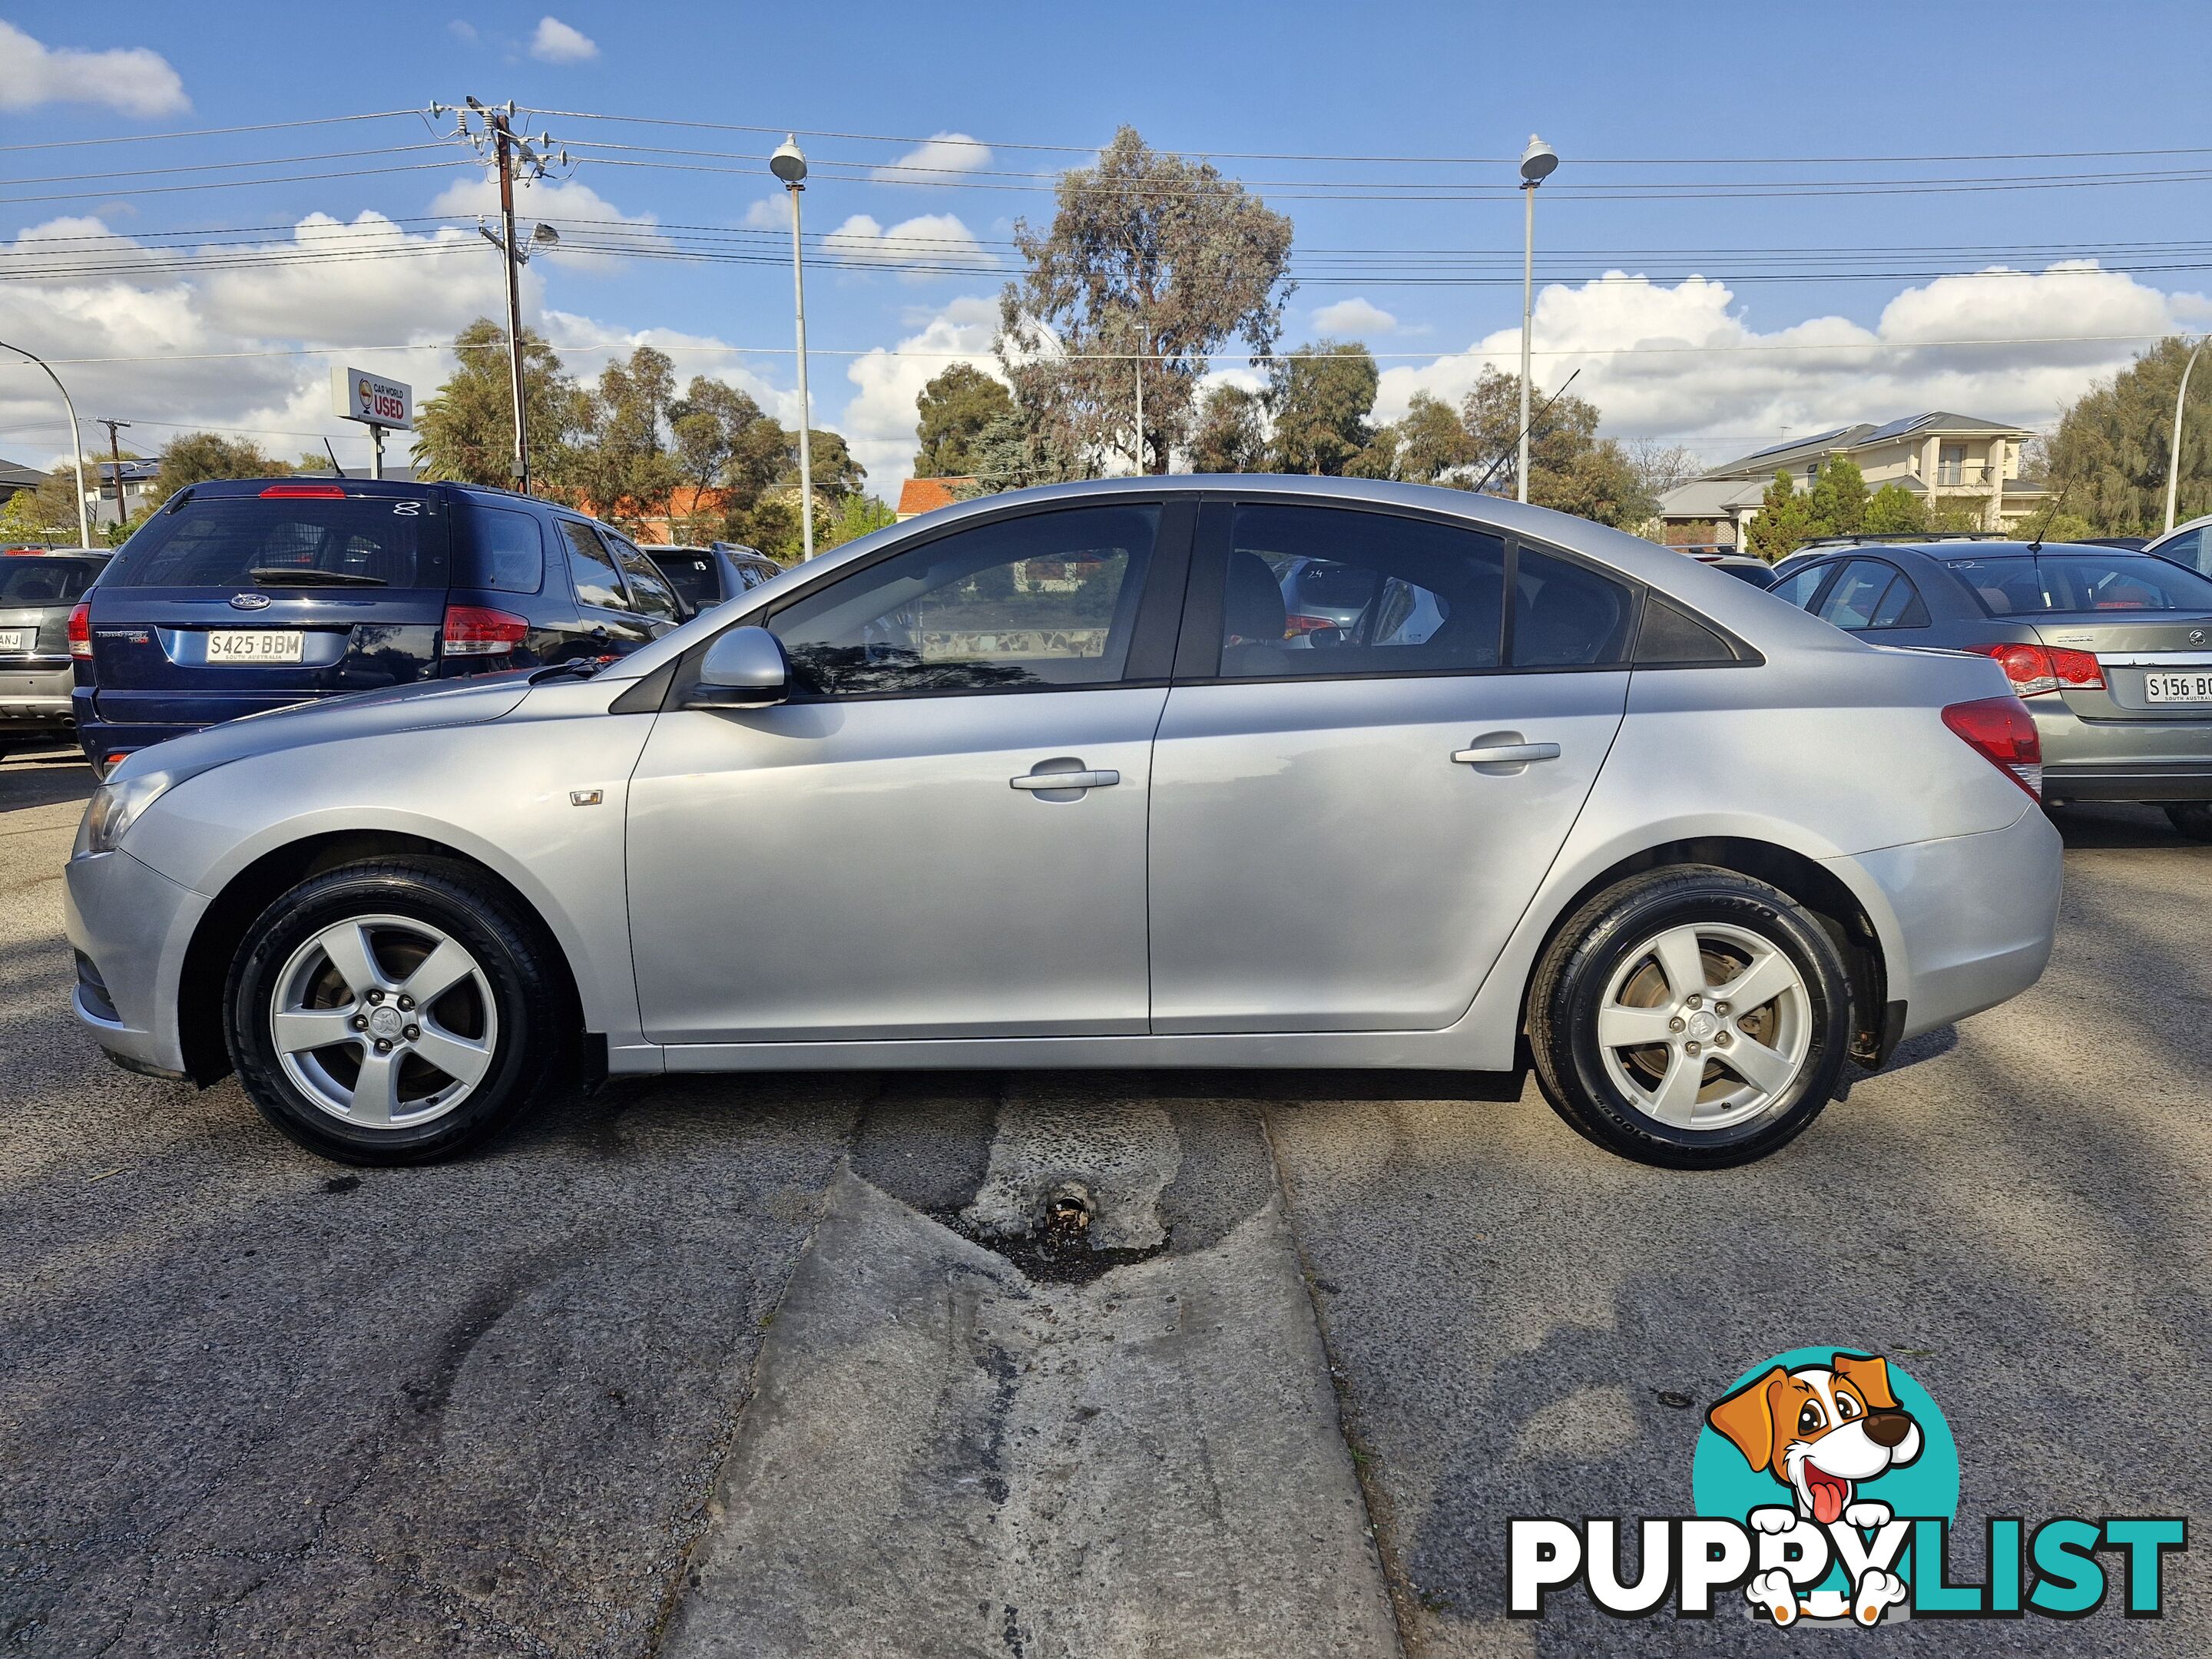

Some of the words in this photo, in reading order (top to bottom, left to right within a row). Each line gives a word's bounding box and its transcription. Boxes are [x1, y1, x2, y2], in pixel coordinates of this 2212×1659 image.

[374, 384, 385, 394] CAR
[386, 386, 403, 399] WORLD
[375, 394, 404, 419] USED
[393, 502, 421, 515] 8
[1307, 569, 1323, 579] 24
